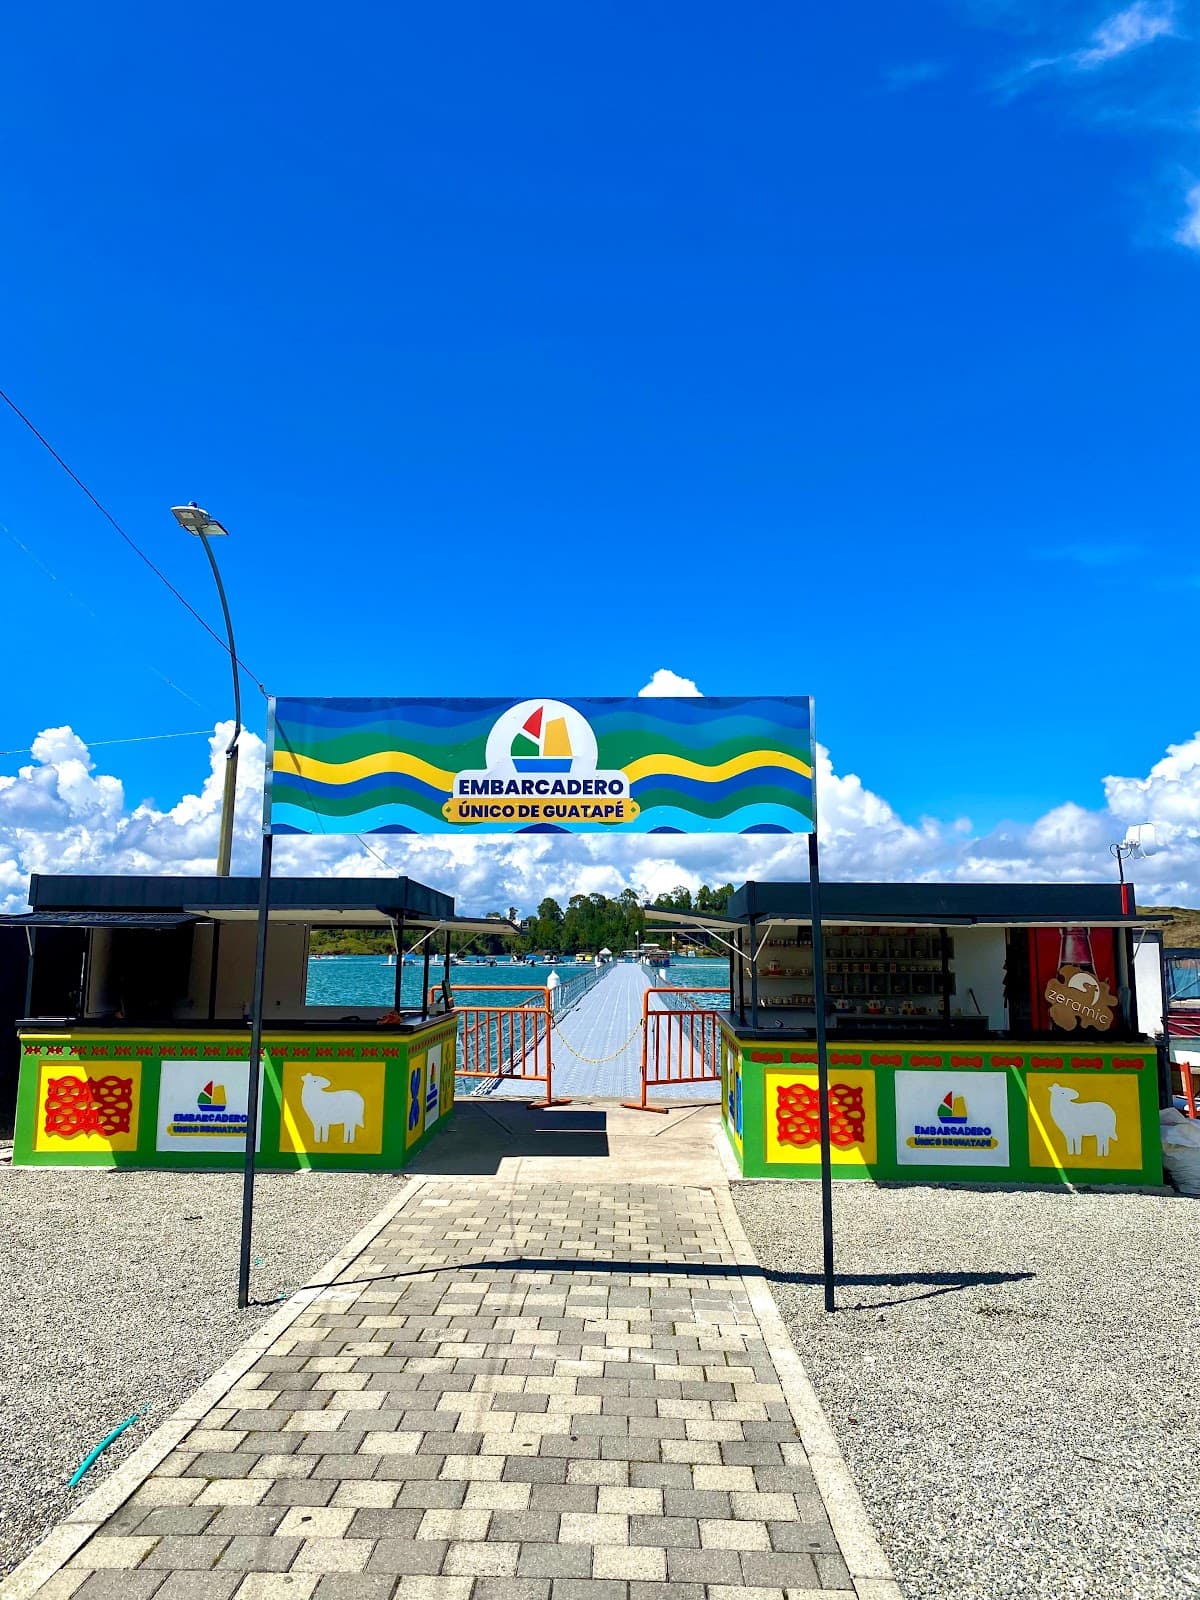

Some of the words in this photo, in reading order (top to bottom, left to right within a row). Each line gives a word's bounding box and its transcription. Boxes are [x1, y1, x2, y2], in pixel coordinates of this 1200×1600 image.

[458, 779, 624, 795] EMBARCADERO
[458, 800, 515, 818] ÚNICO
[518, 805, 540, 818] DE
[542, 800, 624, 818] GUATAPÉ
[1048, 989, 1108, 1024] zeramic
[173, 1113, 248, 1122] EMBARCADERO
[914, 1125, 992, 1136] EMBARCADERO
